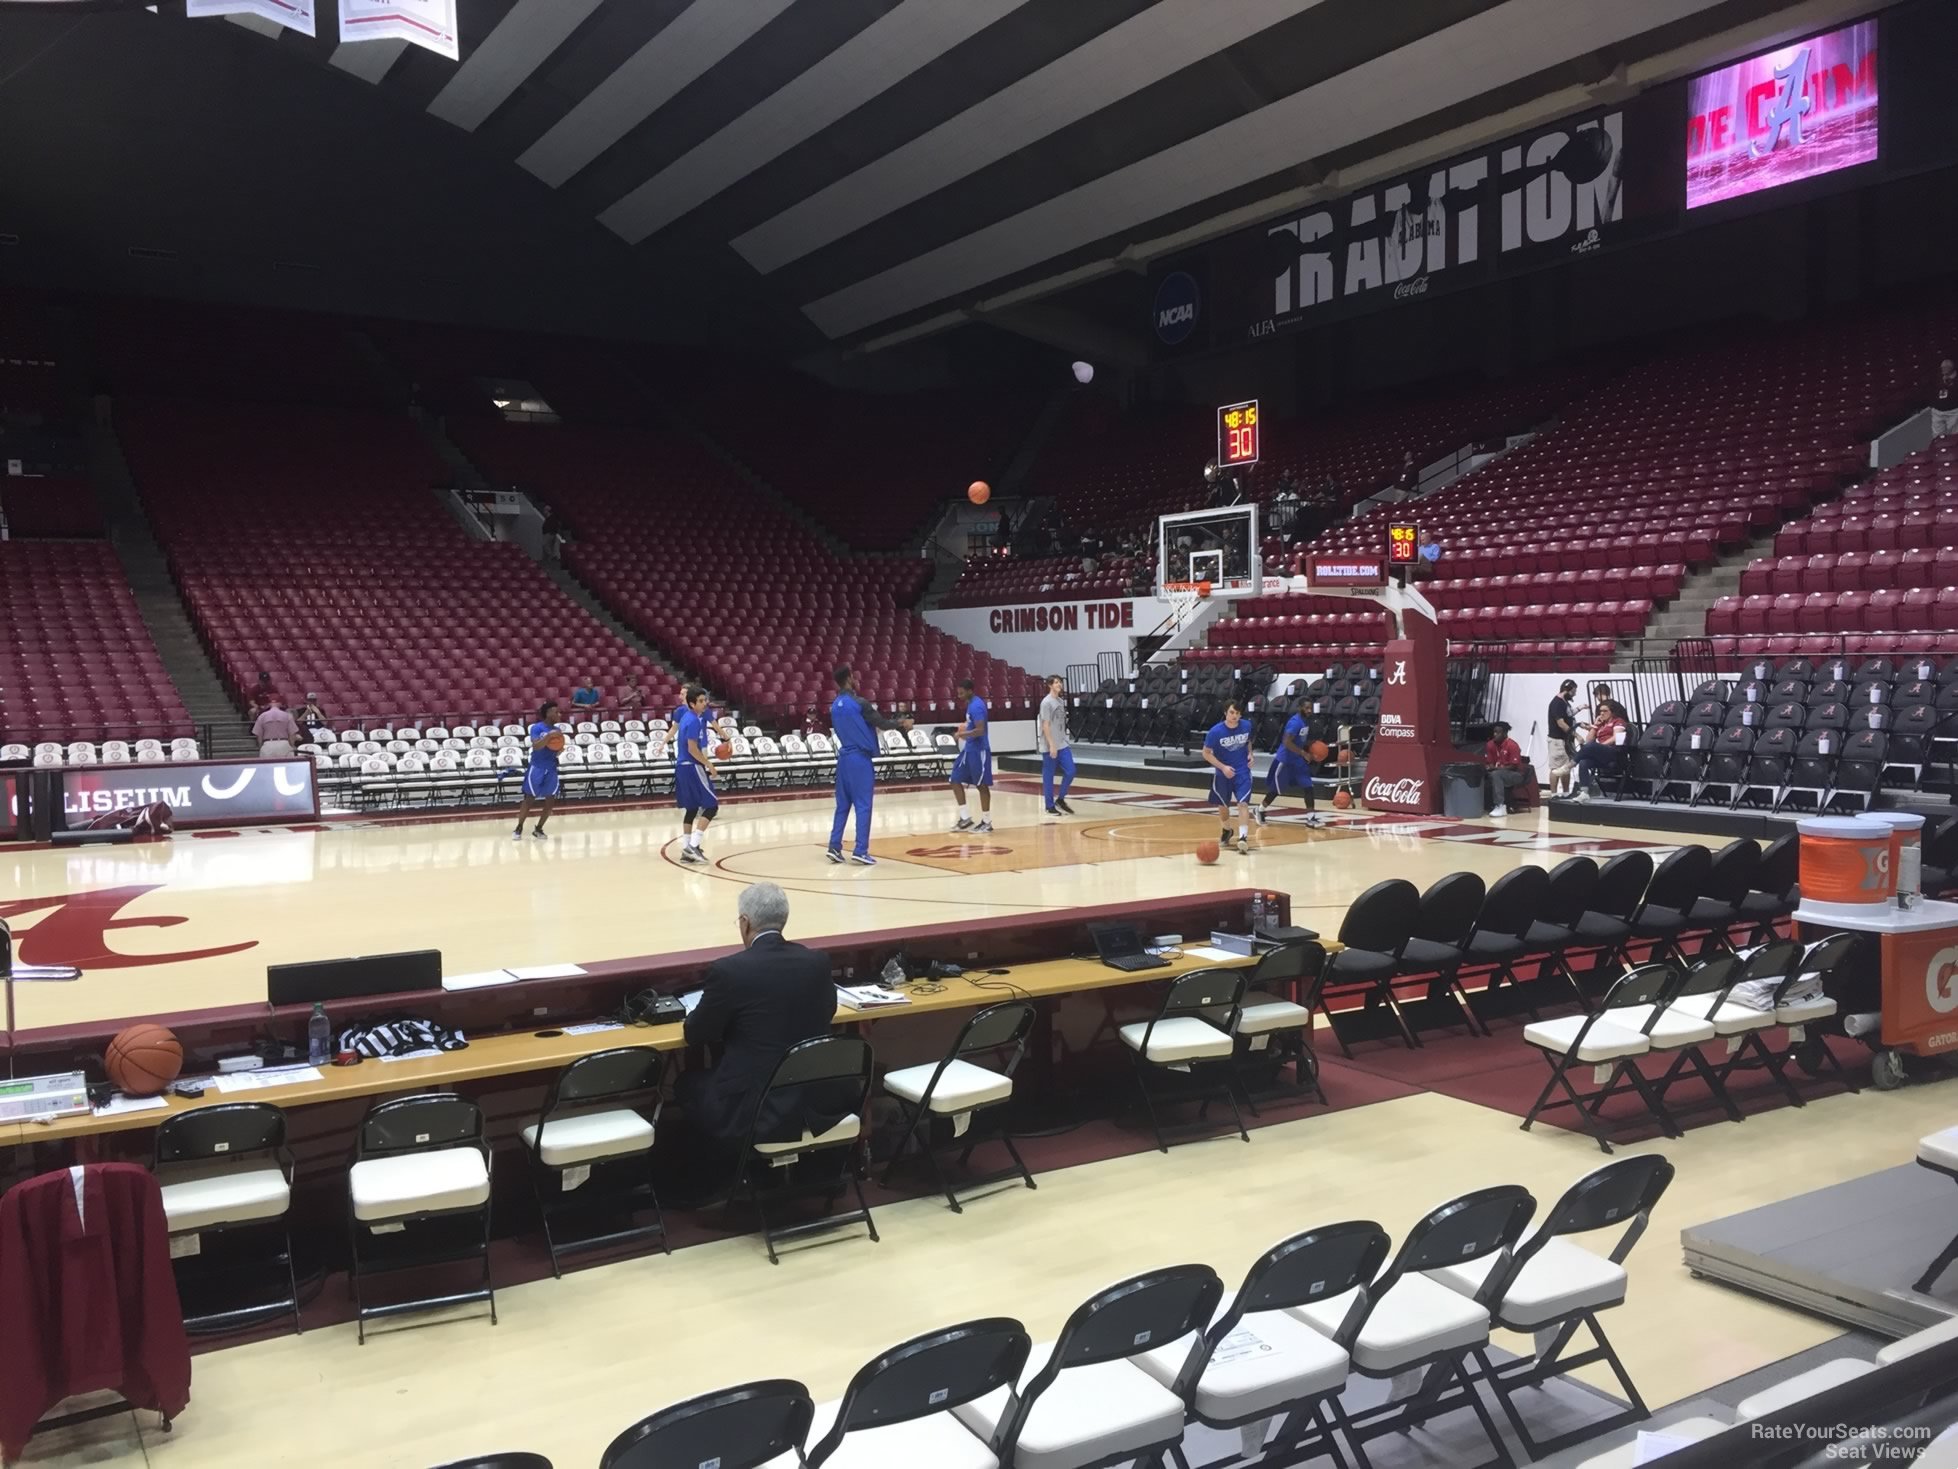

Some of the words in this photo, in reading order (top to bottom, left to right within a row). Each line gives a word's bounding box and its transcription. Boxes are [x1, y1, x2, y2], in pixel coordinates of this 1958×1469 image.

[1159, 303, 1193, 328] NCAA
[1248, 319, 1276, 338] ALFA
[1225, 407, 1257, 428] 48:15
[1229, 427, 1252, 459] 30
[1395, 542, 1410, 558] 30
[1315, 565, 1379, 577] ROLLTIDE.COM
[1351, 588, 1379, 597] SPALDING
[989, 606, 1078, 634] CRIMSON
[1084, 601, 1133, 630] TIDE
[1380, 714, 1402, 725] BBVA
[1380, 726, 1415, 738] Compass
[1364, 776, 1425, 805] Coca-Cola
